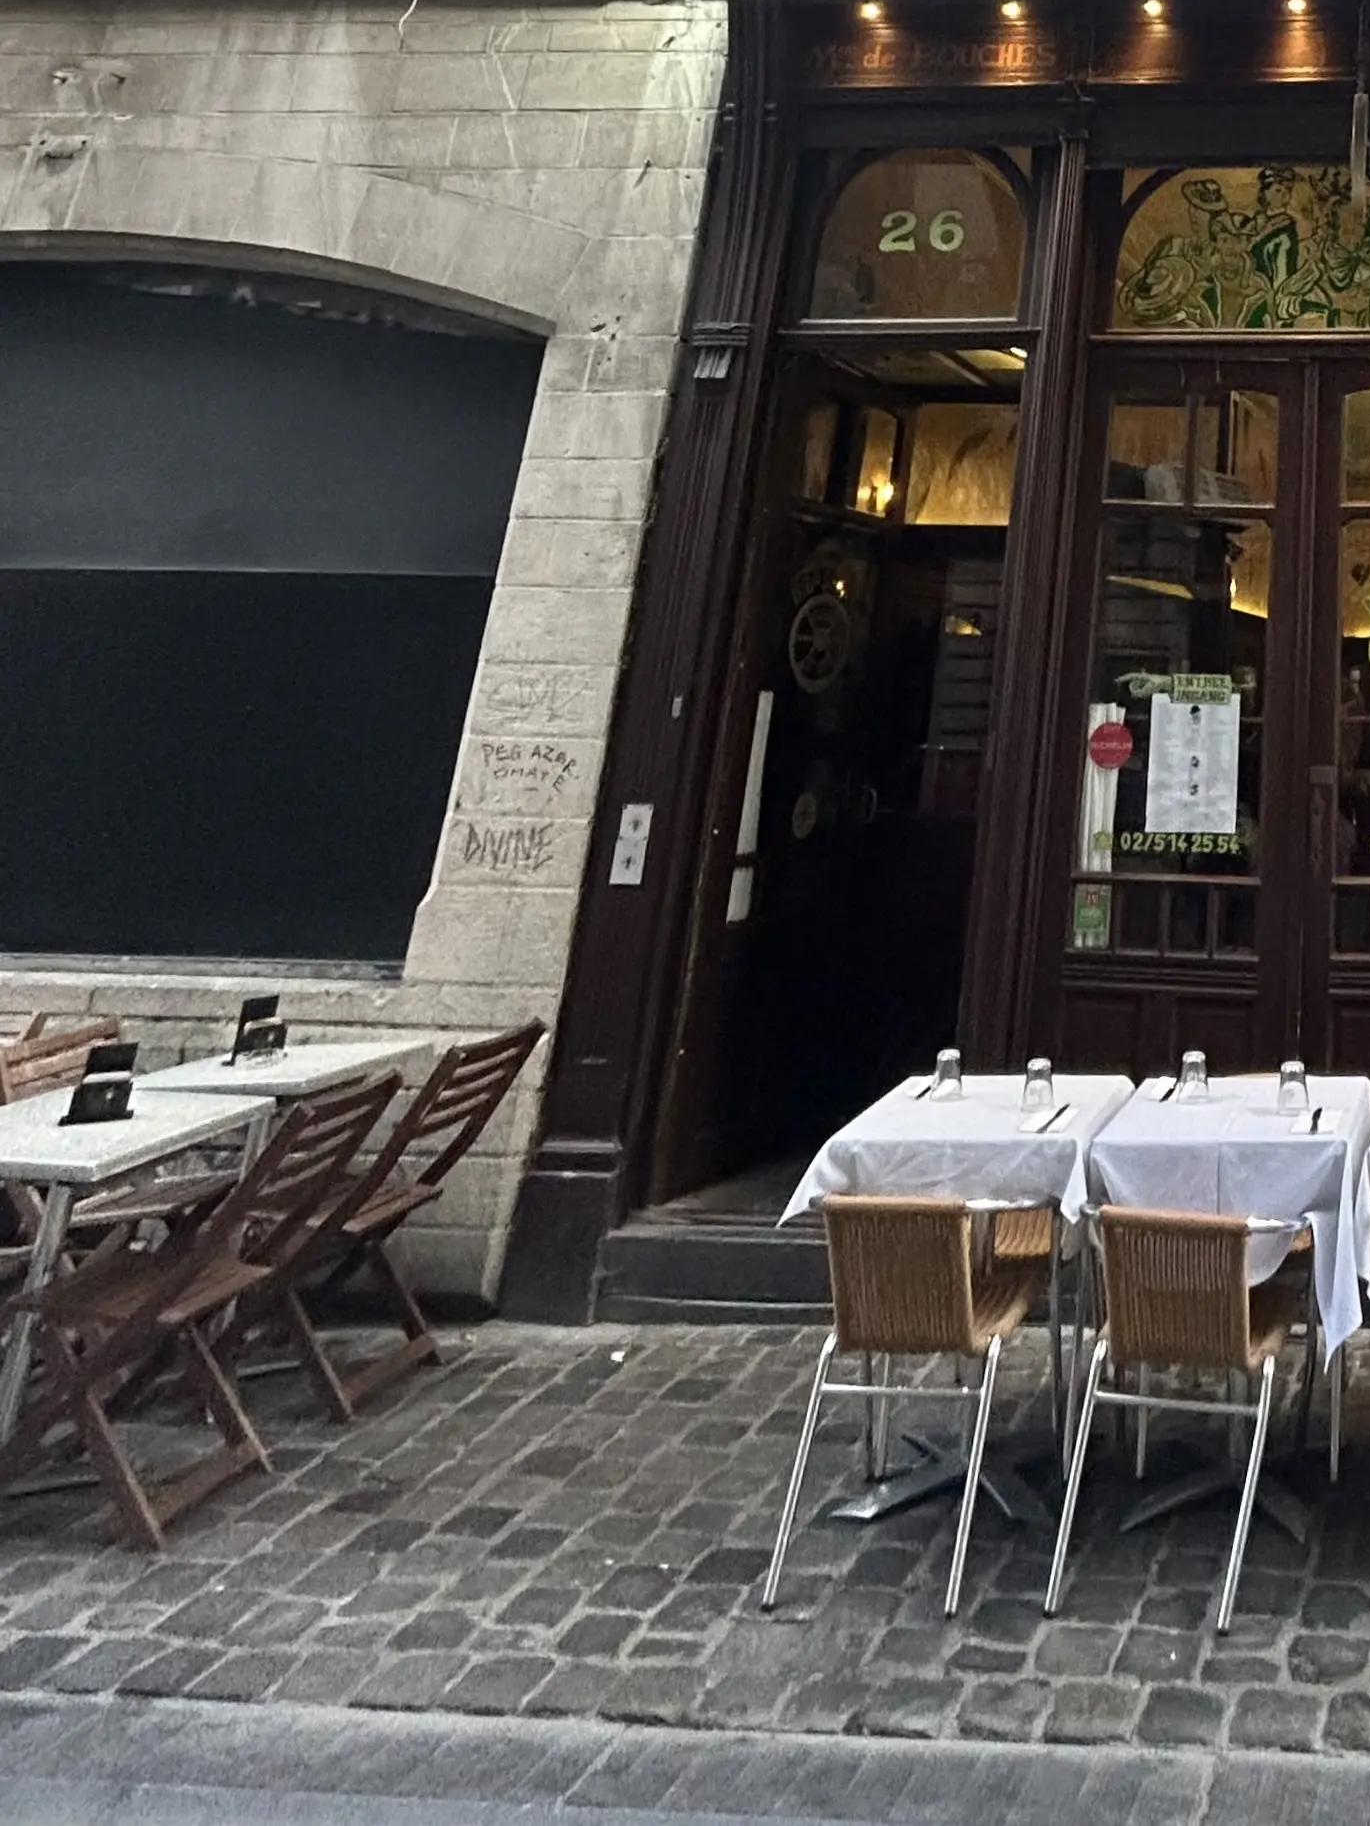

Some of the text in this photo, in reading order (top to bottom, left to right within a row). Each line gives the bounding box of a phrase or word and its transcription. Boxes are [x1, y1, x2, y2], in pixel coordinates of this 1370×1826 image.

[878, 209, 965, 253] 26
[1120, 831, 1240, 855] 02/514 25 54
